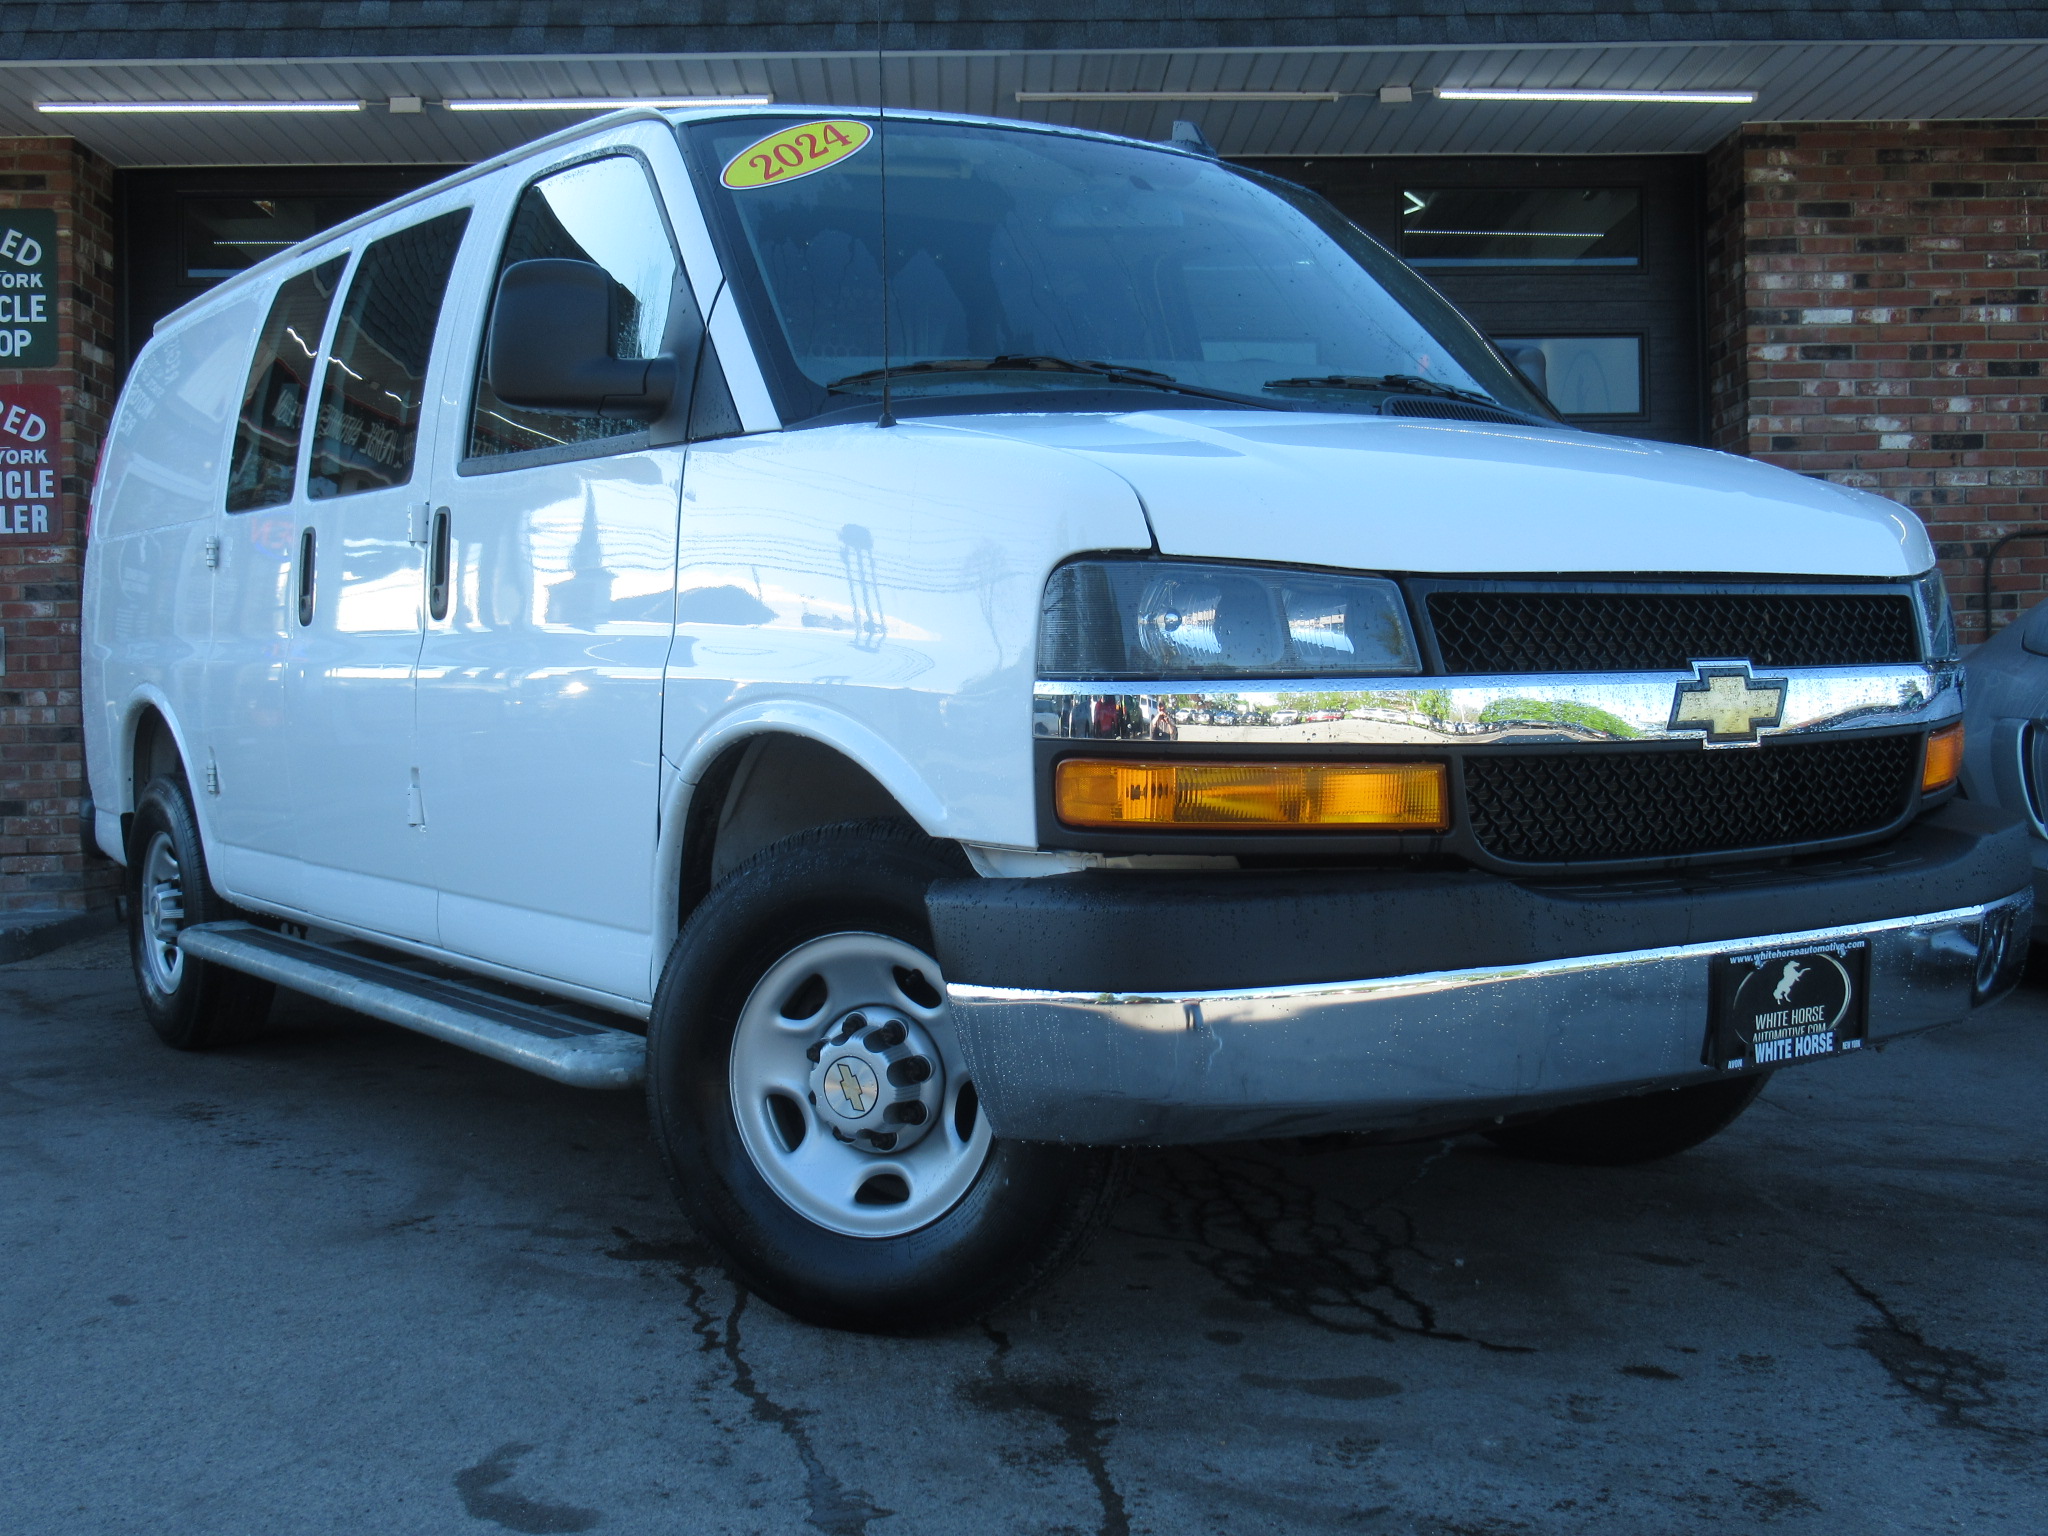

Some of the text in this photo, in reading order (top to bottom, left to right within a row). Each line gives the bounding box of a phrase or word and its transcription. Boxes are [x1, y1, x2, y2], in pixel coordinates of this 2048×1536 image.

[749, 124, 852, 181] 2024
[0, 273, 43, 289] ORK
[0, 294, 47, 323] CLE
[0, 329, 32, 357] OP
[0, 400, 46, 442] ED
[0, 504, 48, 534] LER
[1729, 940, 1865, 964] www.whitehorseautomotive.com
[1755, 1005, 1825, 1030] WHITE HORSE
[1754, 1031, 1834, 1064] WHITE HORSE
[1842, 1041, 1851, 1050] NEW
[1727, 1058, 1743, 1069] AVON
